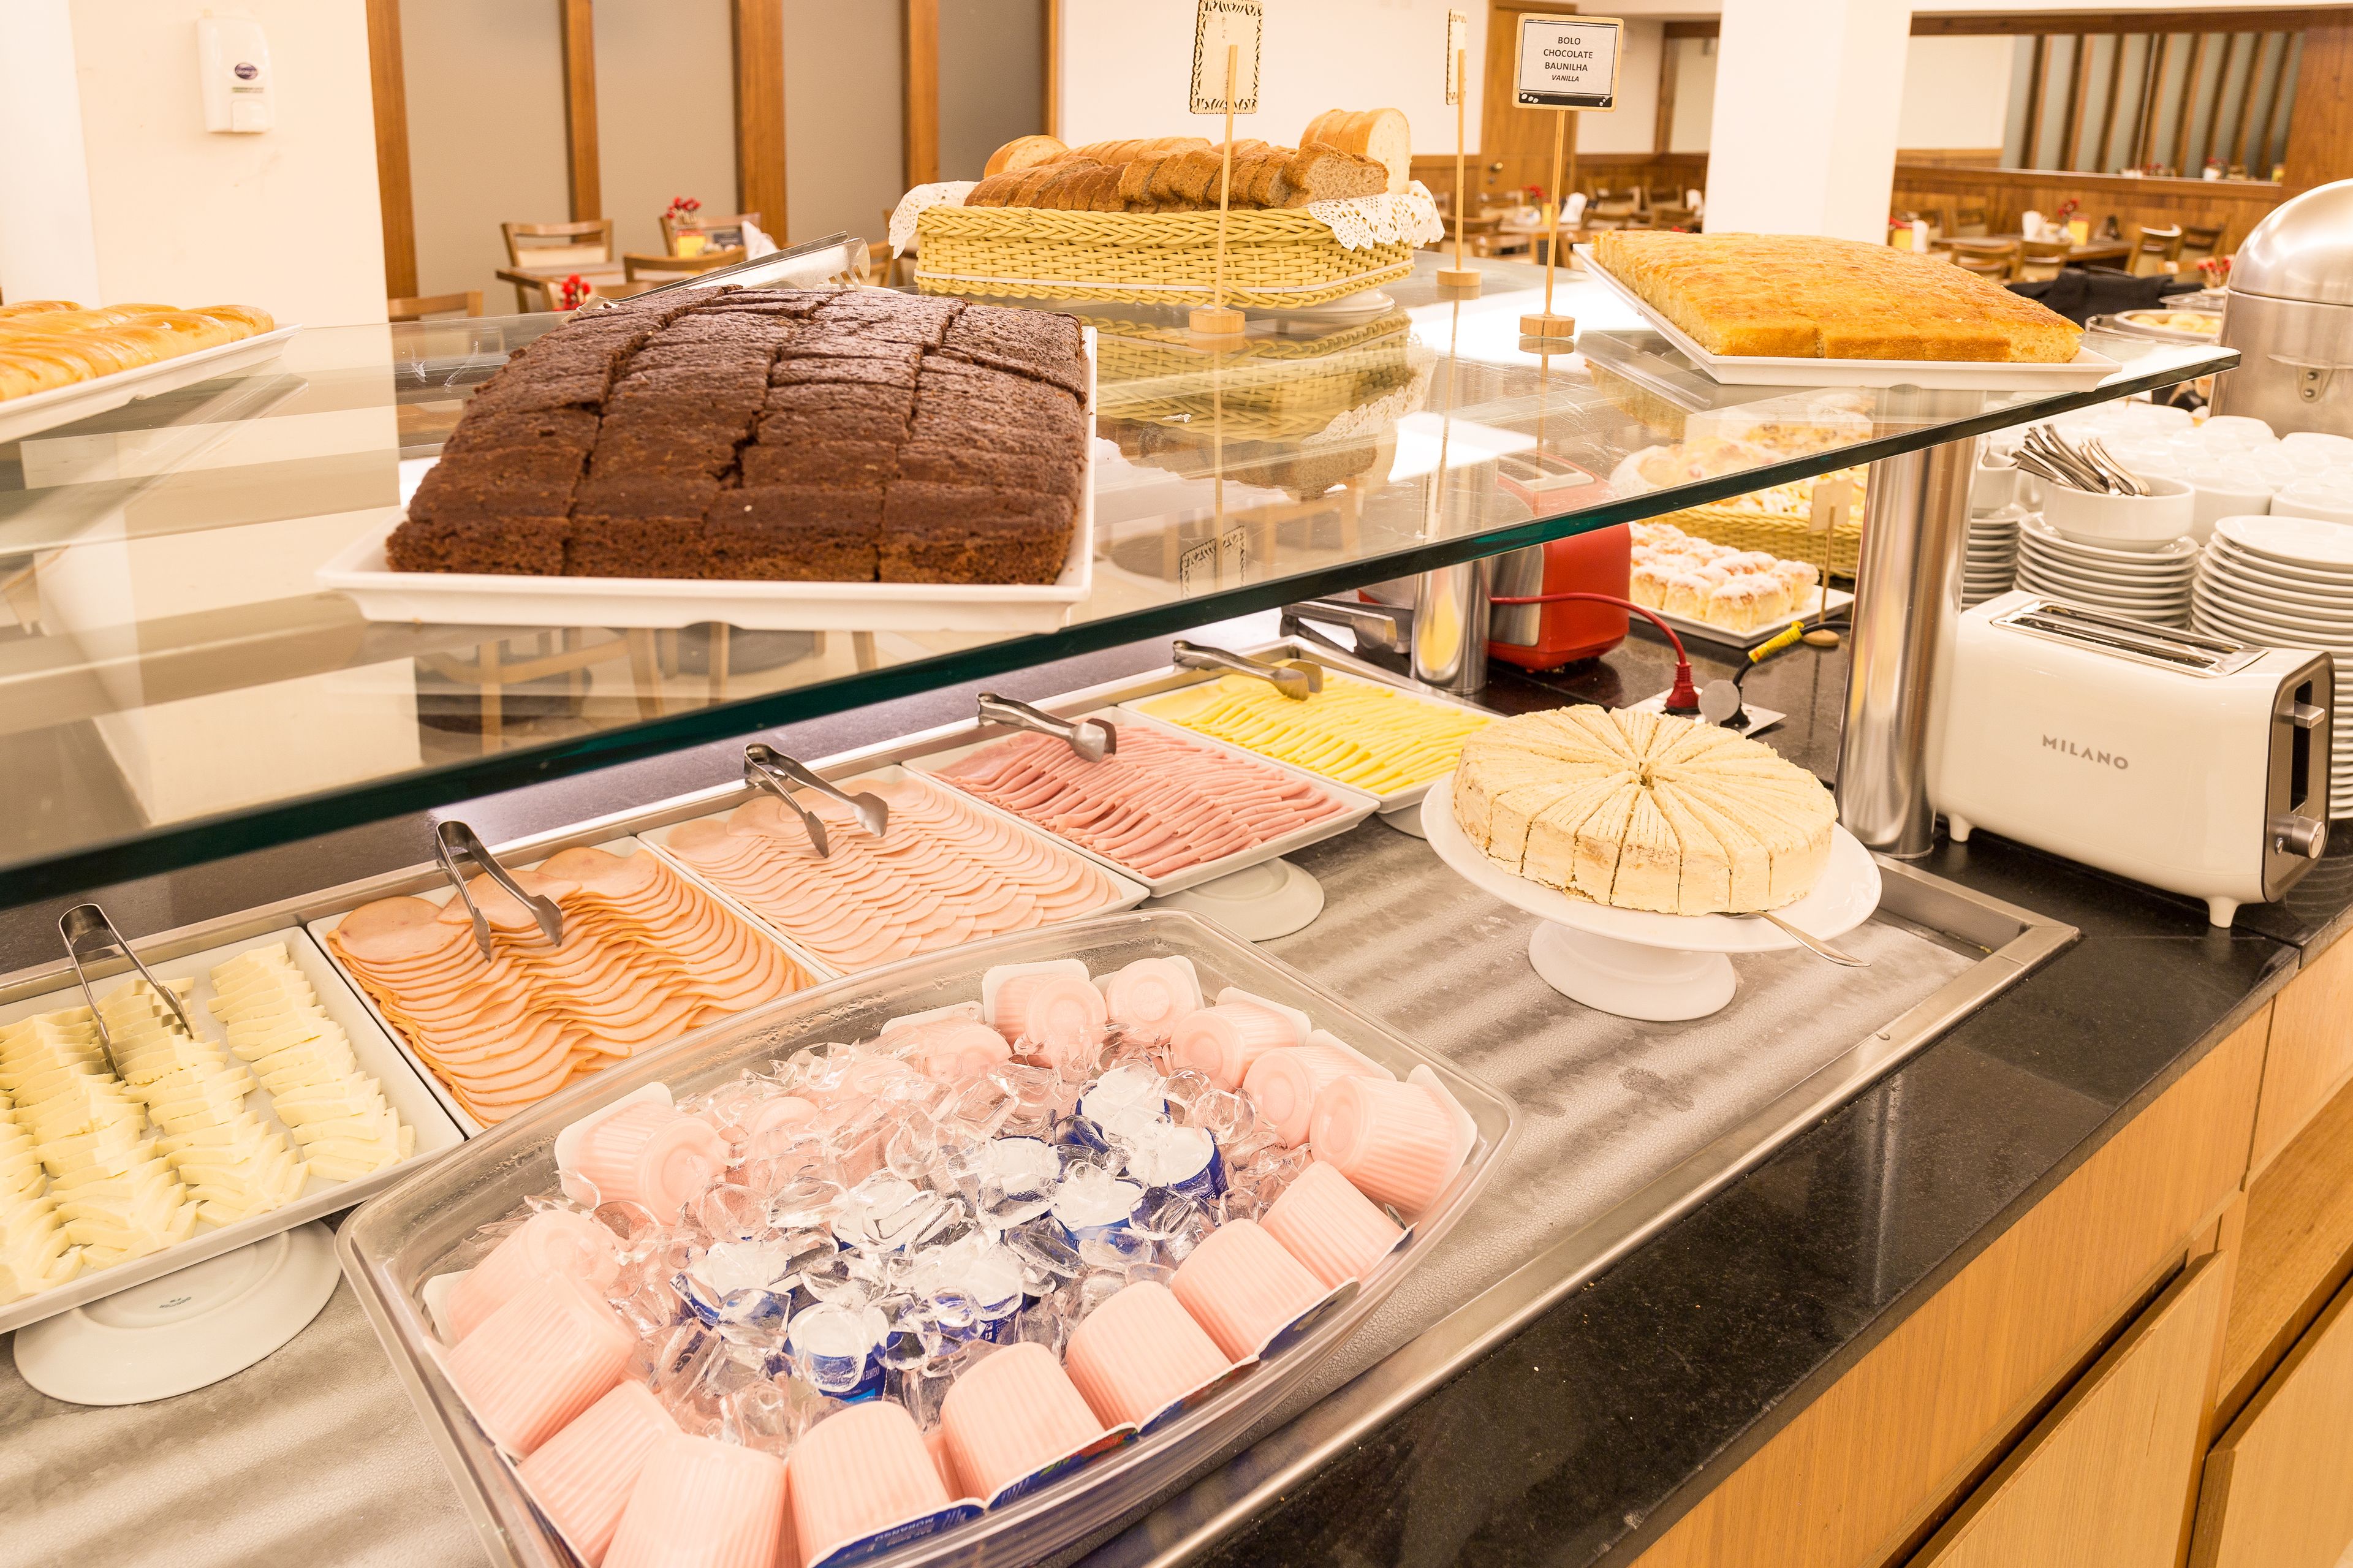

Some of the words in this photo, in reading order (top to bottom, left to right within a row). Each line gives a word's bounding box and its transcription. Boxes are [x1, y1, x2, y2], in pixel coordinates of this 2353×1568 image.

[1558, 37, 1581, 45] BOLO
[1544, 49, 1593, 59] CHOCOLATE
[1545, 62, 1588, 71] BAUNILHA
[2042, 734, 2128, 770] MILANO
